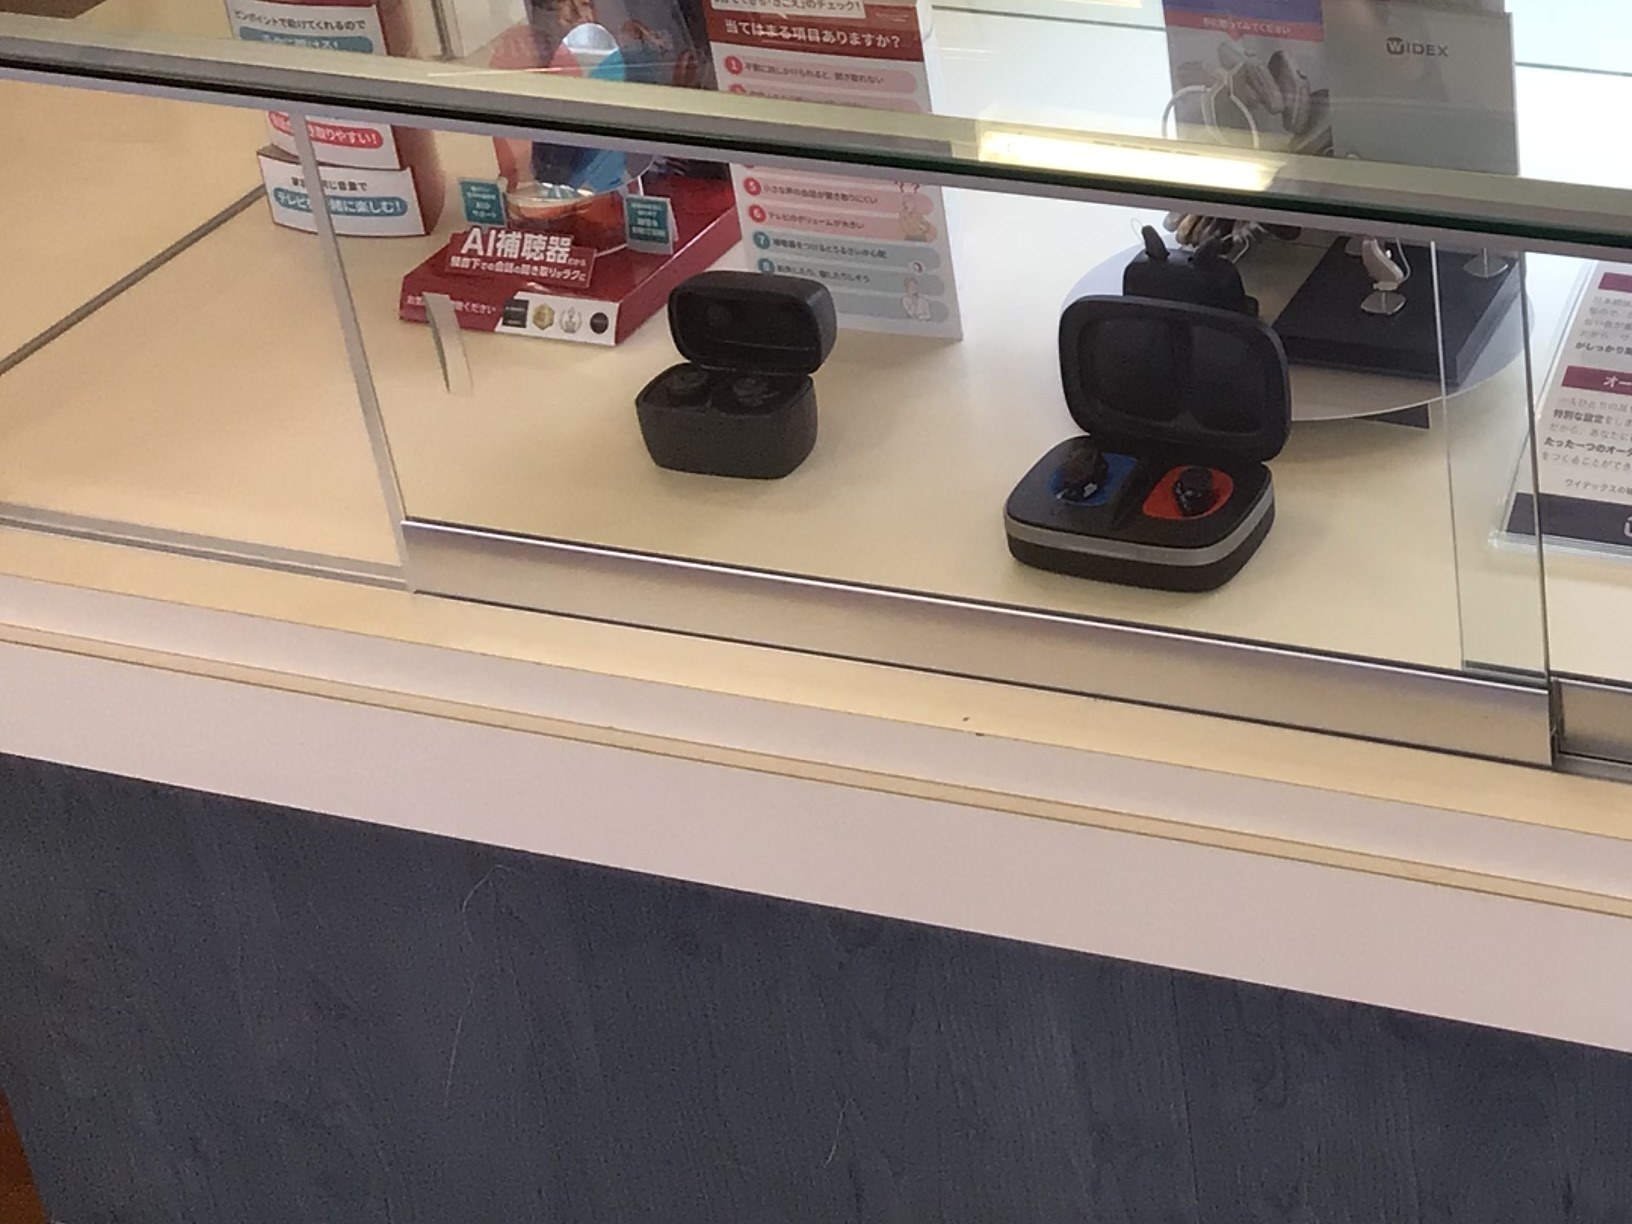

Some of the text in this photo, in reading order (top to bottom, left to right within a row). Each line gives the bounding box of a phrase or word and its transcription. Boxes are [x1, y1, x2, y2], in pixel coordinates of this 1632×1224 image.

[725, 19, 900, 48] 当てはまる項目ありますか?
[1386, 37, 1448, 57] WIDEX
